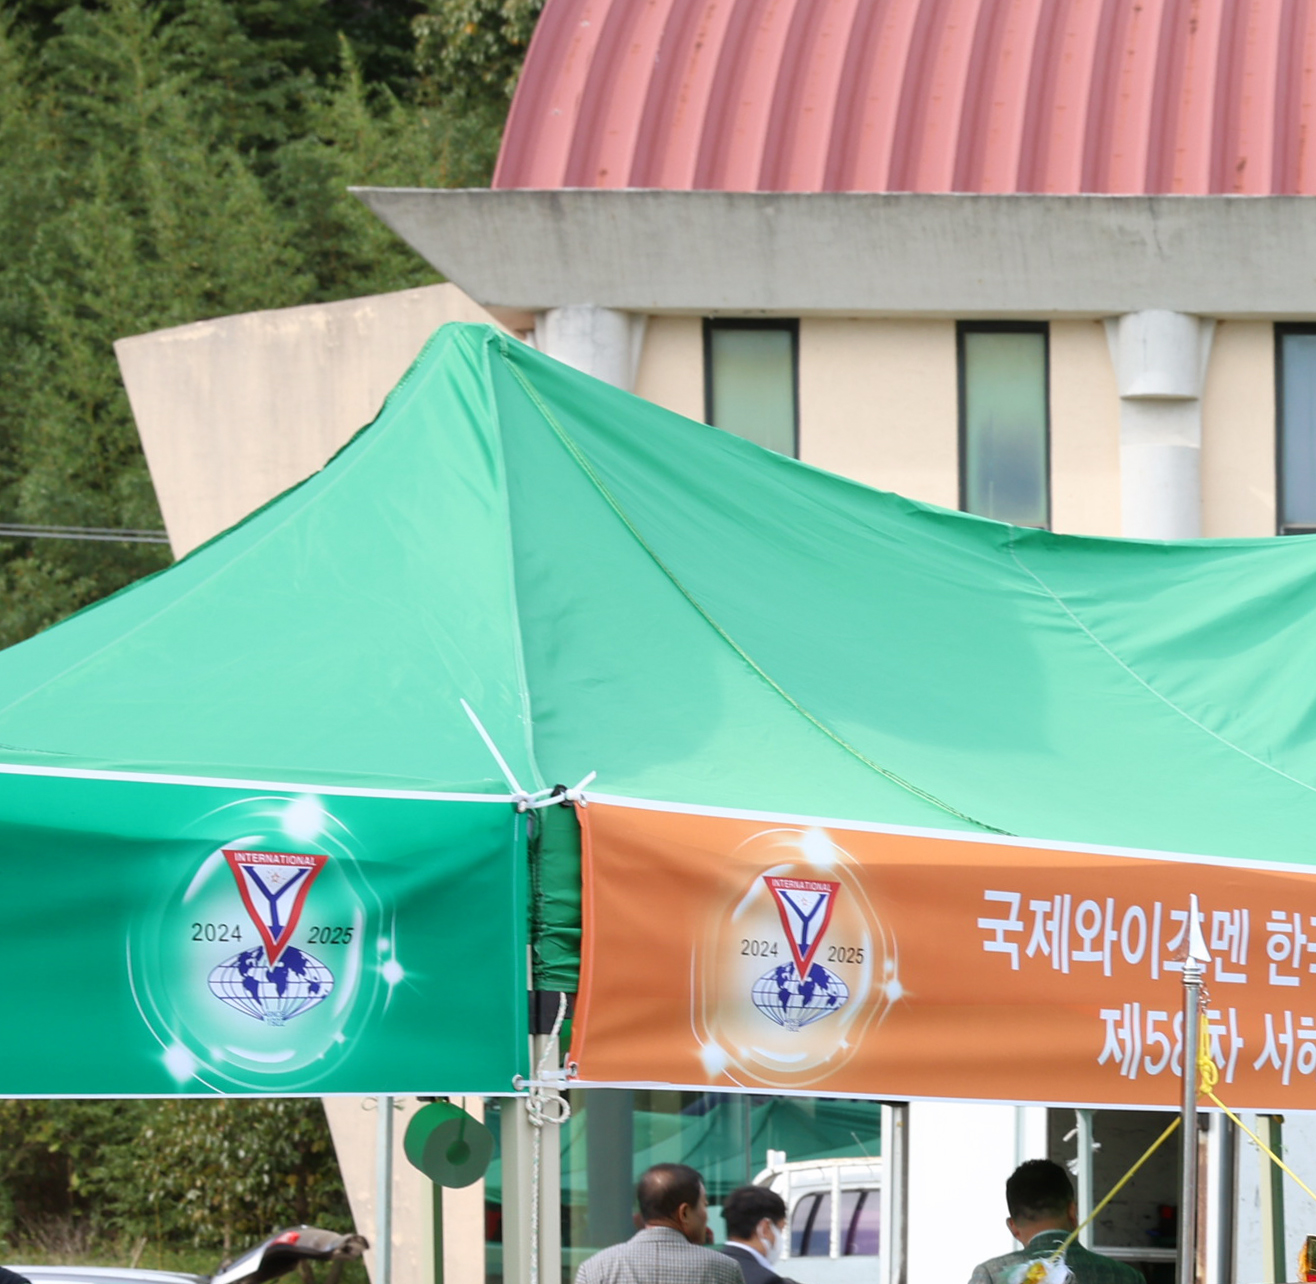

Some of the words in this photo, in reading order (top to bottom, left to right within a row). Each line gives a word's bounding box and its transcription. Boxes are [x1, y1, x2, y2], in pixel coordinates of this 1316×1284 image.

[234, 852, 317, 866] INTERNATIONAL
[771, 879, 832, 892] INTERNATIONAL
[191, 922, 242, 942] 2024
[307, 926, 354, 945] 2025
[977, 890, 1249, 984] 국제와이즈멘
[741, 939, 778, 958] 2024
[827, 946, 864, 964] 2025
